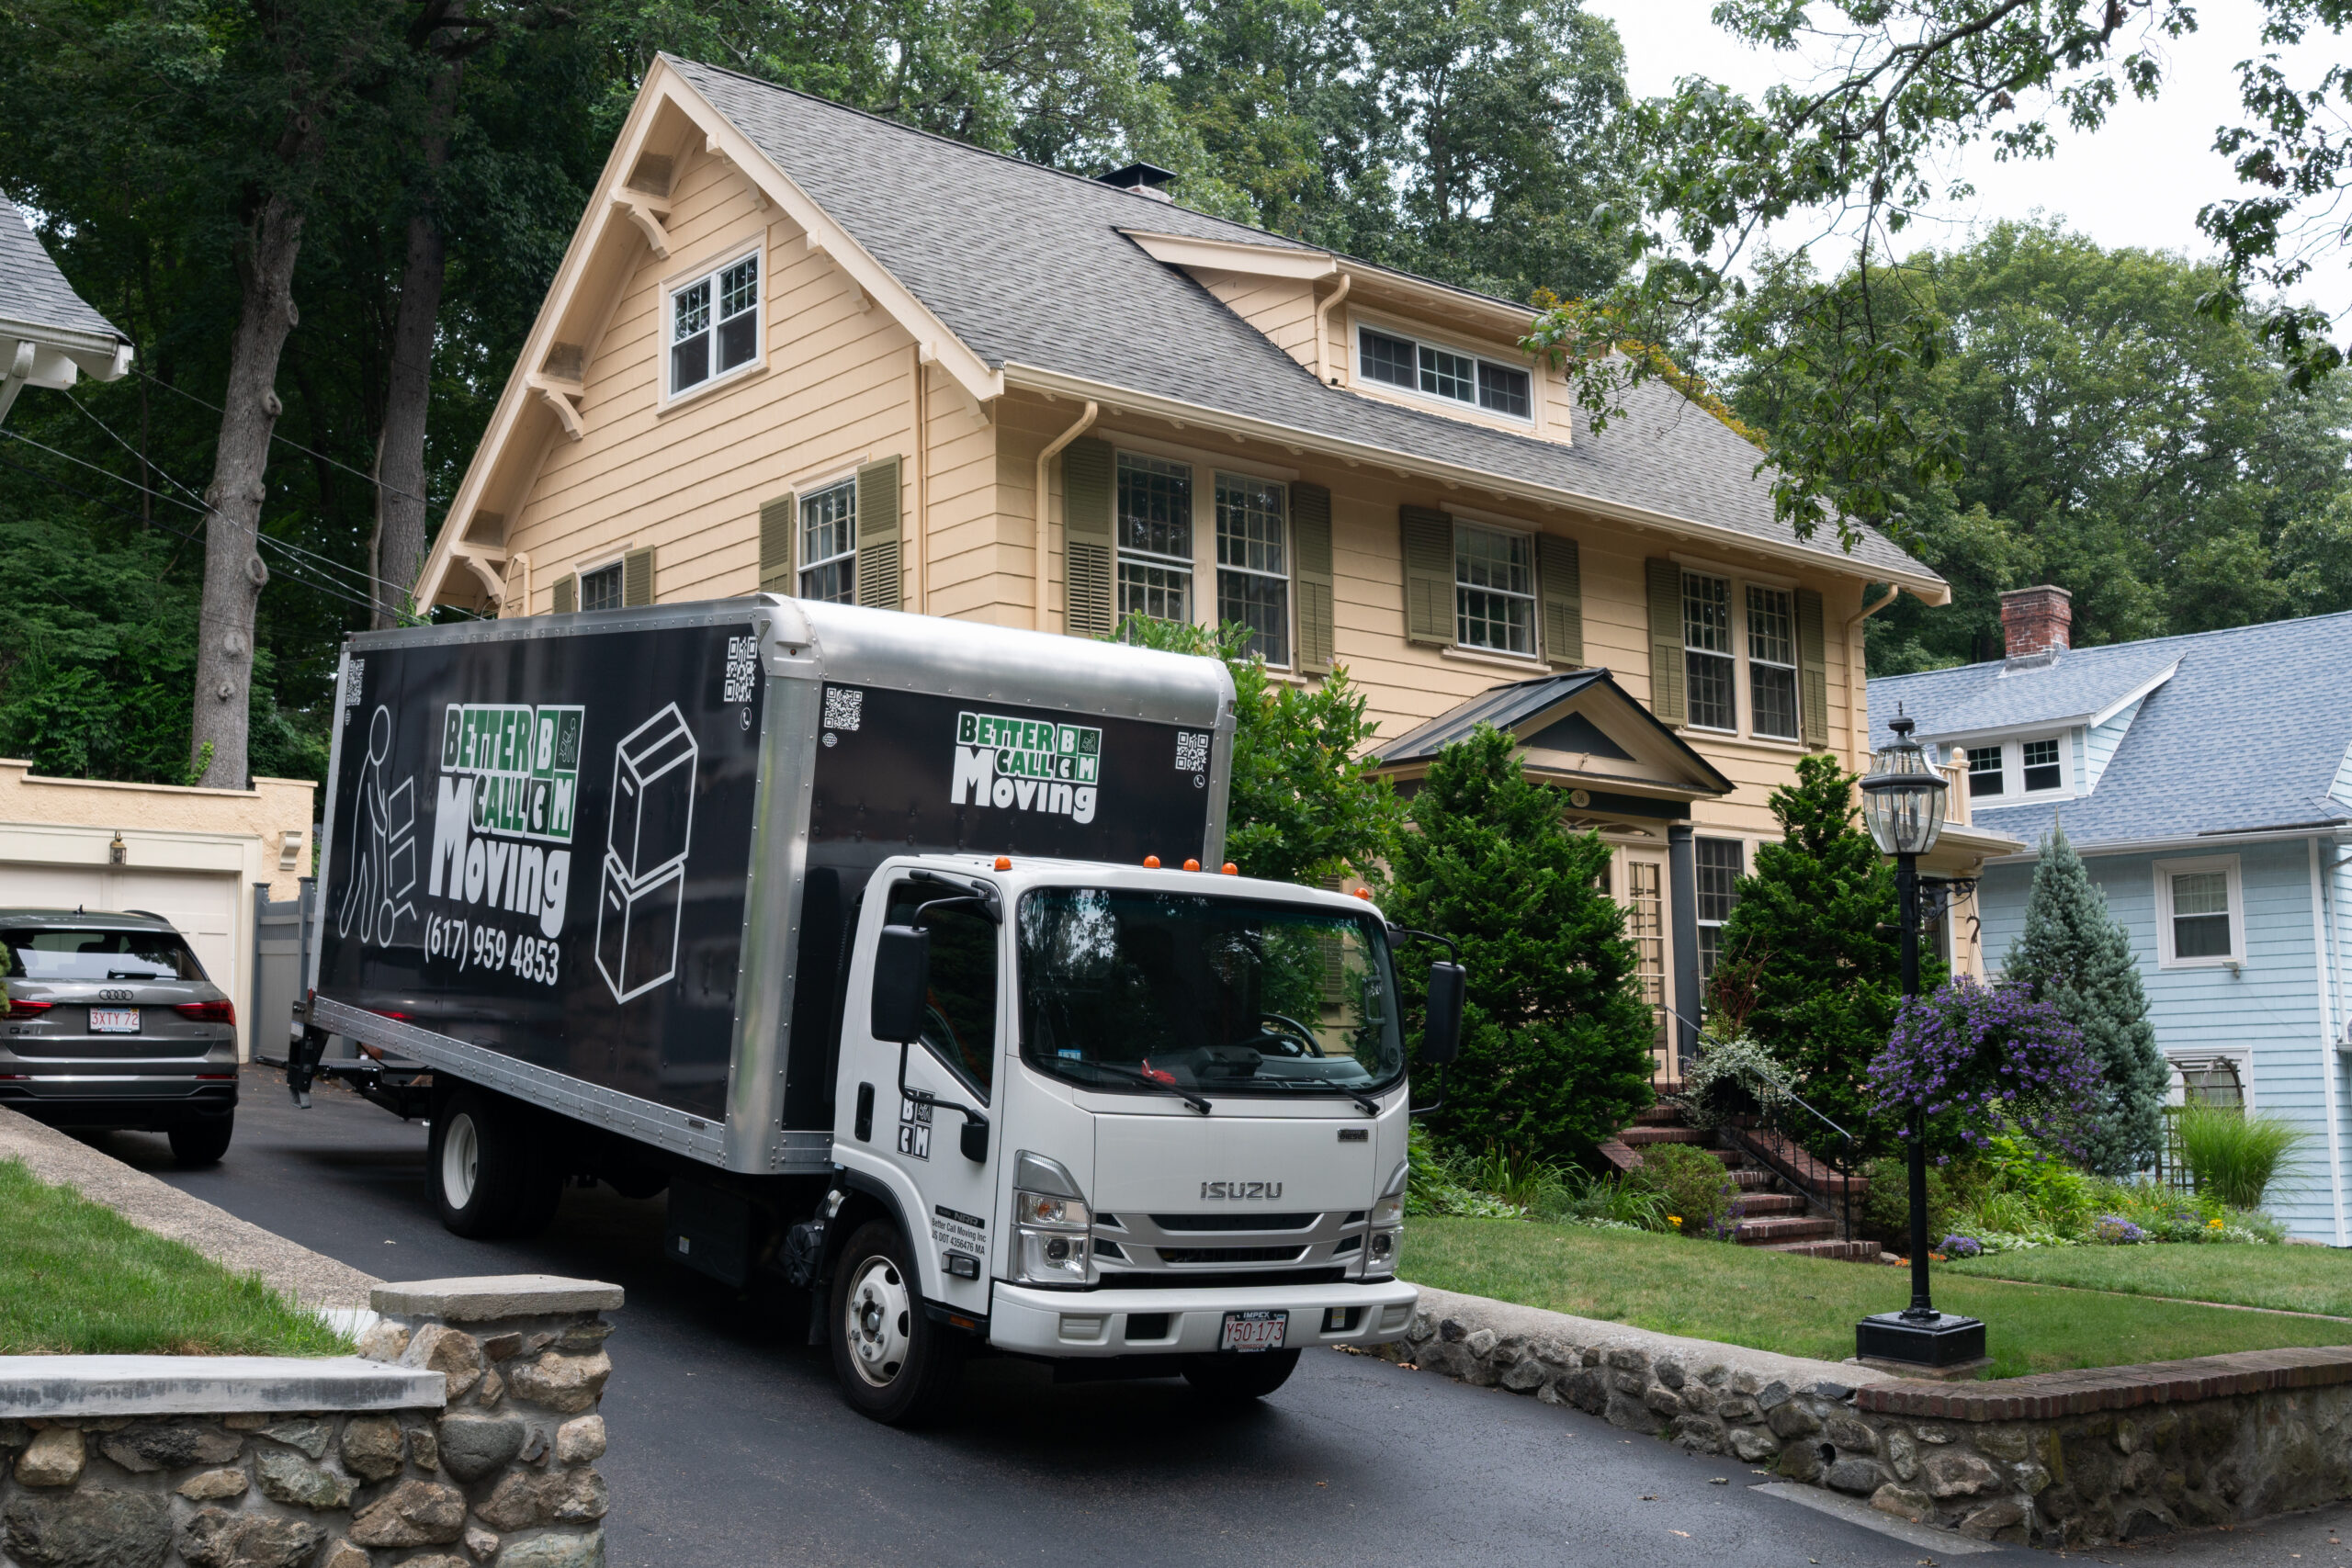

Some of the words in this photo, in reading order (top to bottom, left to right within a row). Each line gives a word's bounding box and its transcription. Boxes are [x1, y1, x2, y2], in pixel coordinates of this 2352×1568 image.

[442, 705, 534, 777] BETTER
[537, 718, 553, 770] B
[957, 712, 1055, 754] BETTER
[1060, 729, 1075, 753] B
[995, 749, 1053, 780] CALL
[1059, 758, 1071, 778] C
[1079, 757, 1094, 780] M
[951, 746, 1097, 824] Moving
[471, 773, 526, 836] CALL
[533, 785, 546, 830] C
[551, 778, 573, 831] M
[428, 776, 571, 939] Moving
[424, 911, 469, 973] (617)
[473, 925, 506, 971] 959
[510, 934, 560, 987] 4853
[91, 1011, 120, 1025] 3XTY
[124, 1012, 140, 1026] 72
[900, 1127, 910, 1153] C
[914, 1126, 929, 1157] M
[1200, 1181, 1283, 1199] ISUZU
[932, 1217, 946, 1231] Better
[946, 1222, 957, 1234] Call
[957, 1225, 977, 1242] Moving
[977, 1232, 987, 1243] Inc
[954, 1213, 978, 1226] NRR
[938, 1232, 950, 1245] DOT
[950, 1235, 974, 1252] 4356476
[974, 1244, 986, 1256] MA
[1243, 1311, 1271, 1319] IMPEX
